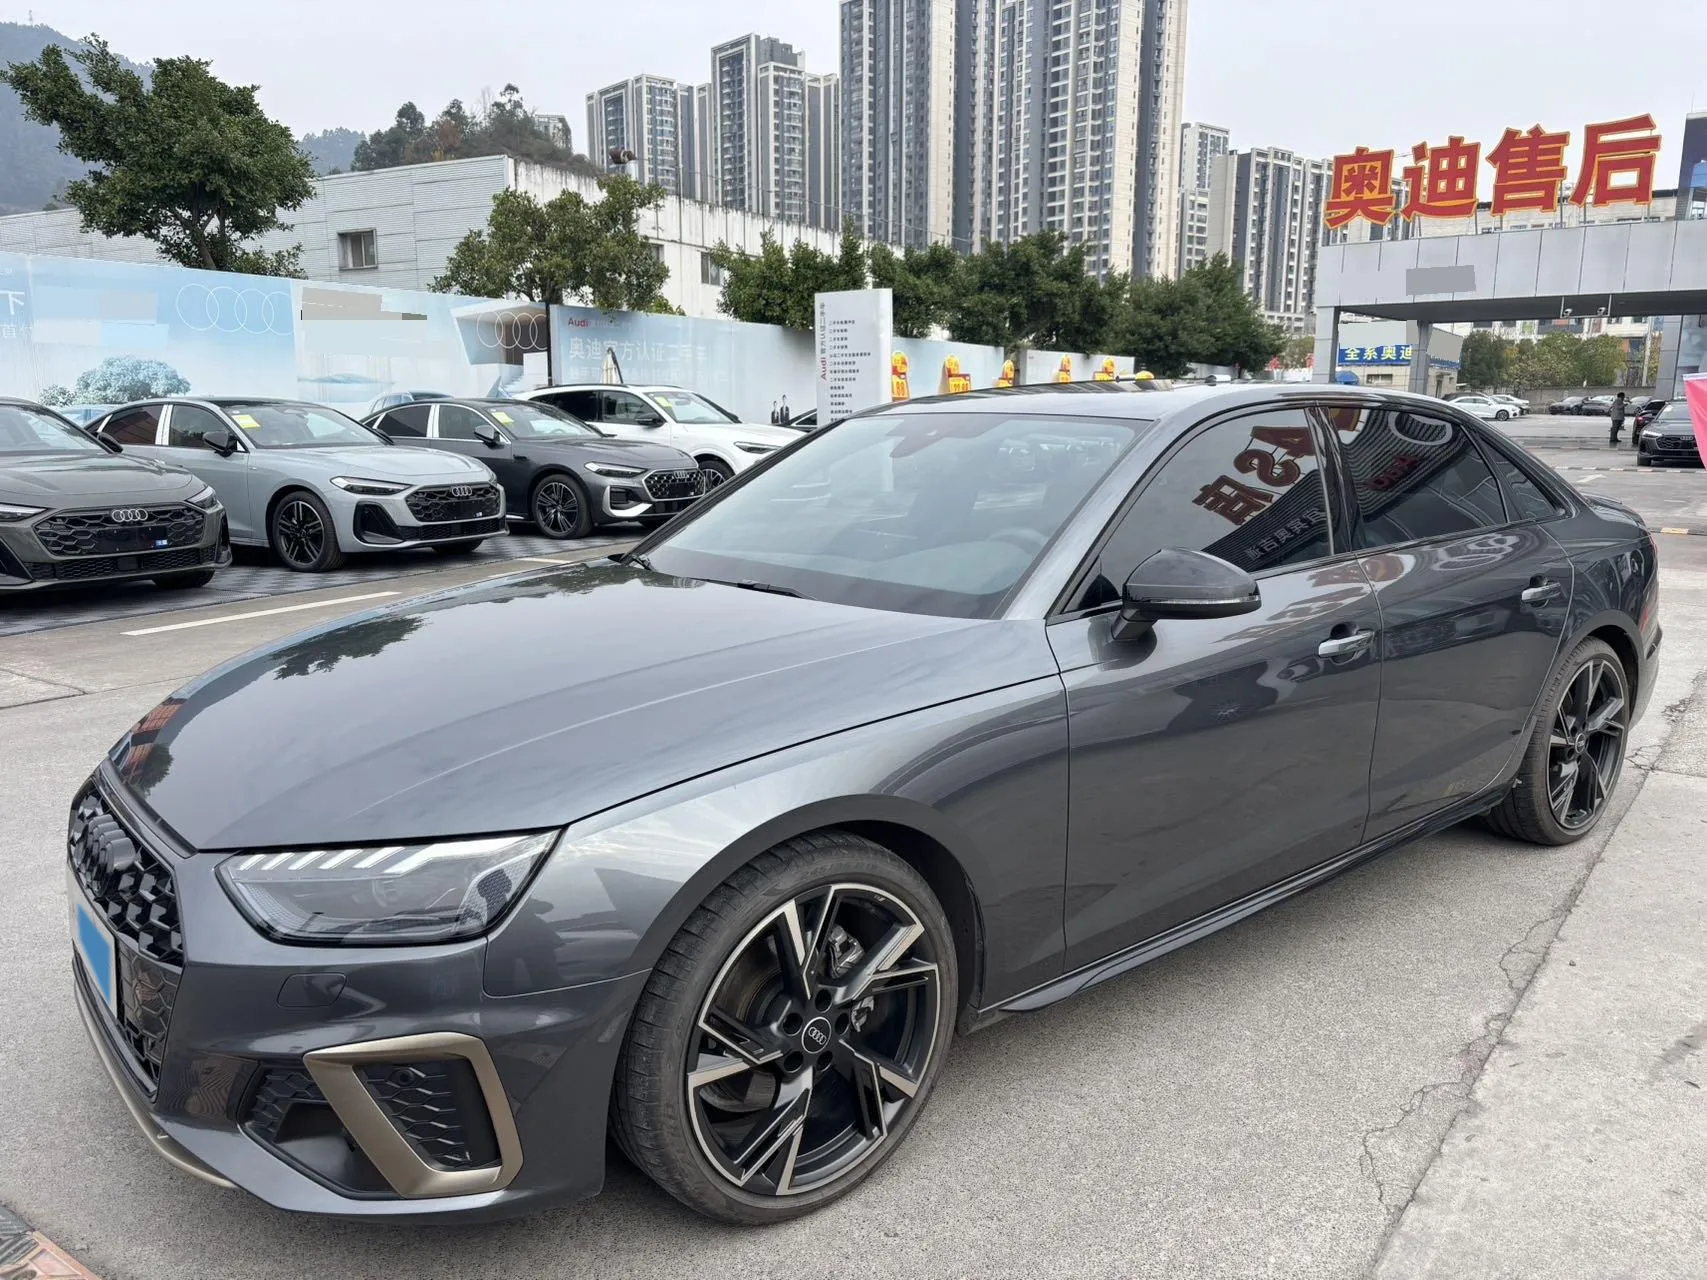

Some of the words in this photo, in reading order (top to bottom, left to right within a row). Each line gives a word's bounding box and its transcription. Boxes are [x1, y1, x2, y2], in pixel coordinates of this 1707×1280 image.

[1324, 113, 1663, 229] 奥迪售后
[568, 317, 589, 328] Audi
